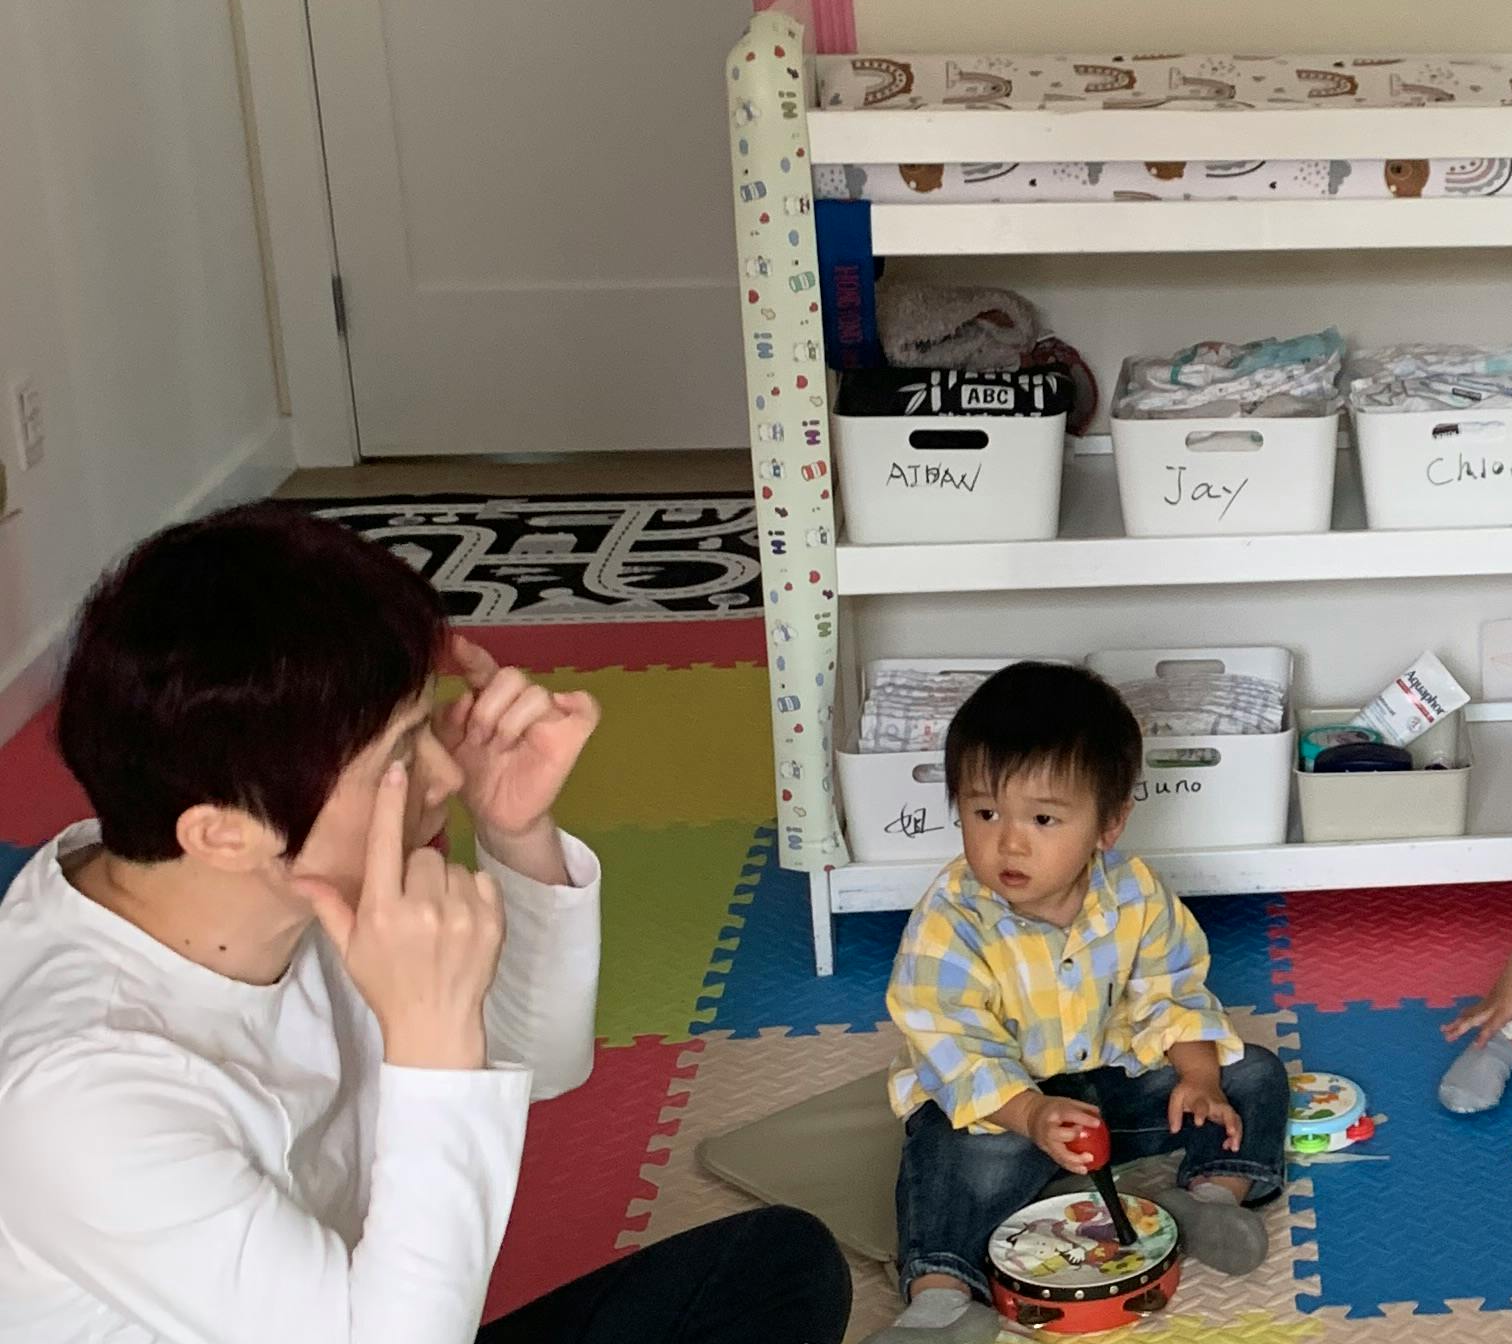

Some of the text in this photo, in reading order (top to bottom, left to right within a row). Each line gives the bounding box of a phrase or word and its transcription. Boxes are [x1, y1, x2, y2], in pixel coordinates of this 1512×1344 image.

[778, 90, 798, 120] Hi
[753, 332, 774, 359] Hi
[967, 387, 1009, 405] ABC
[802, 420, 822, 446] Hi
[1164, 465, 1249, 522] Jay
[767, 530, 787, 555] Hi
[814, 612, 833, 638] Hi
[1405, 671, 1445, 715] Aquaphor
[1134, 780, 1202, 802] Juno
[785, 825, 803, 850] Hi
